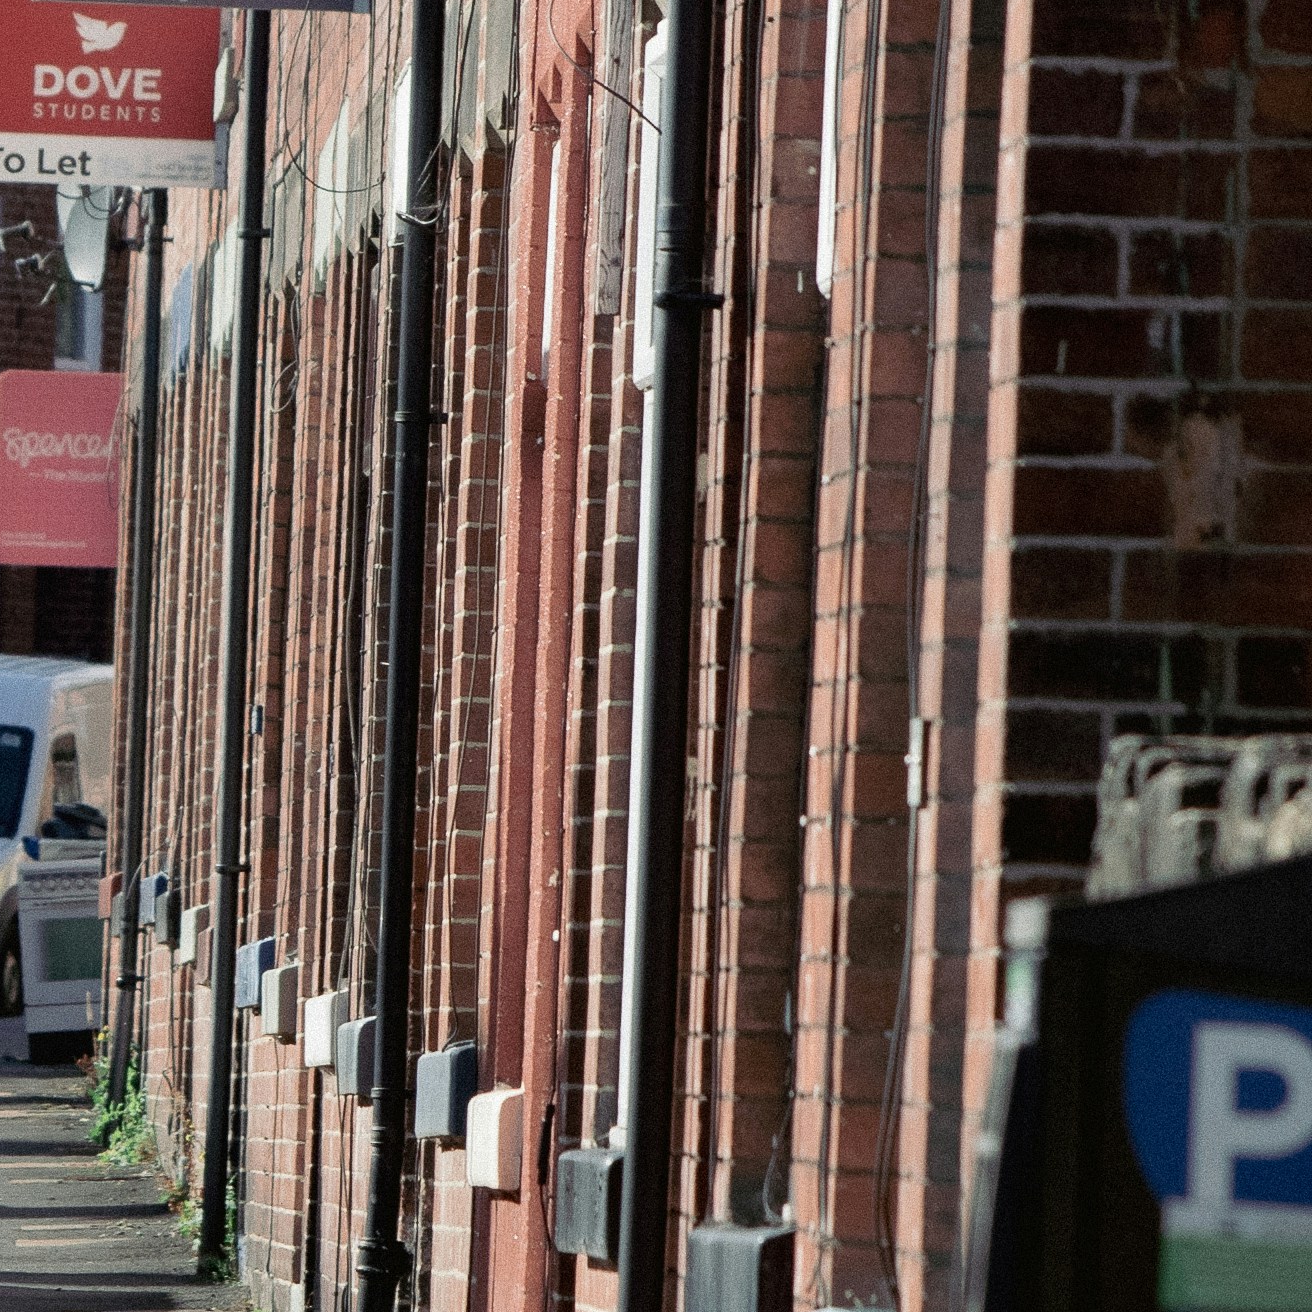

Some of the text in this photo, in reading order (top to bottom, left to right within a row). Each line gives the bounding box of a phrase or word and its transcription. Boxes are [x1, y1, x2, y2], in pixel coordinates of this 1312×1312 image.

[32, 64, 163, 101] DOVE
[31, 102, 162, 122] STUDENTS
[38, 148, 92, 177] Let
